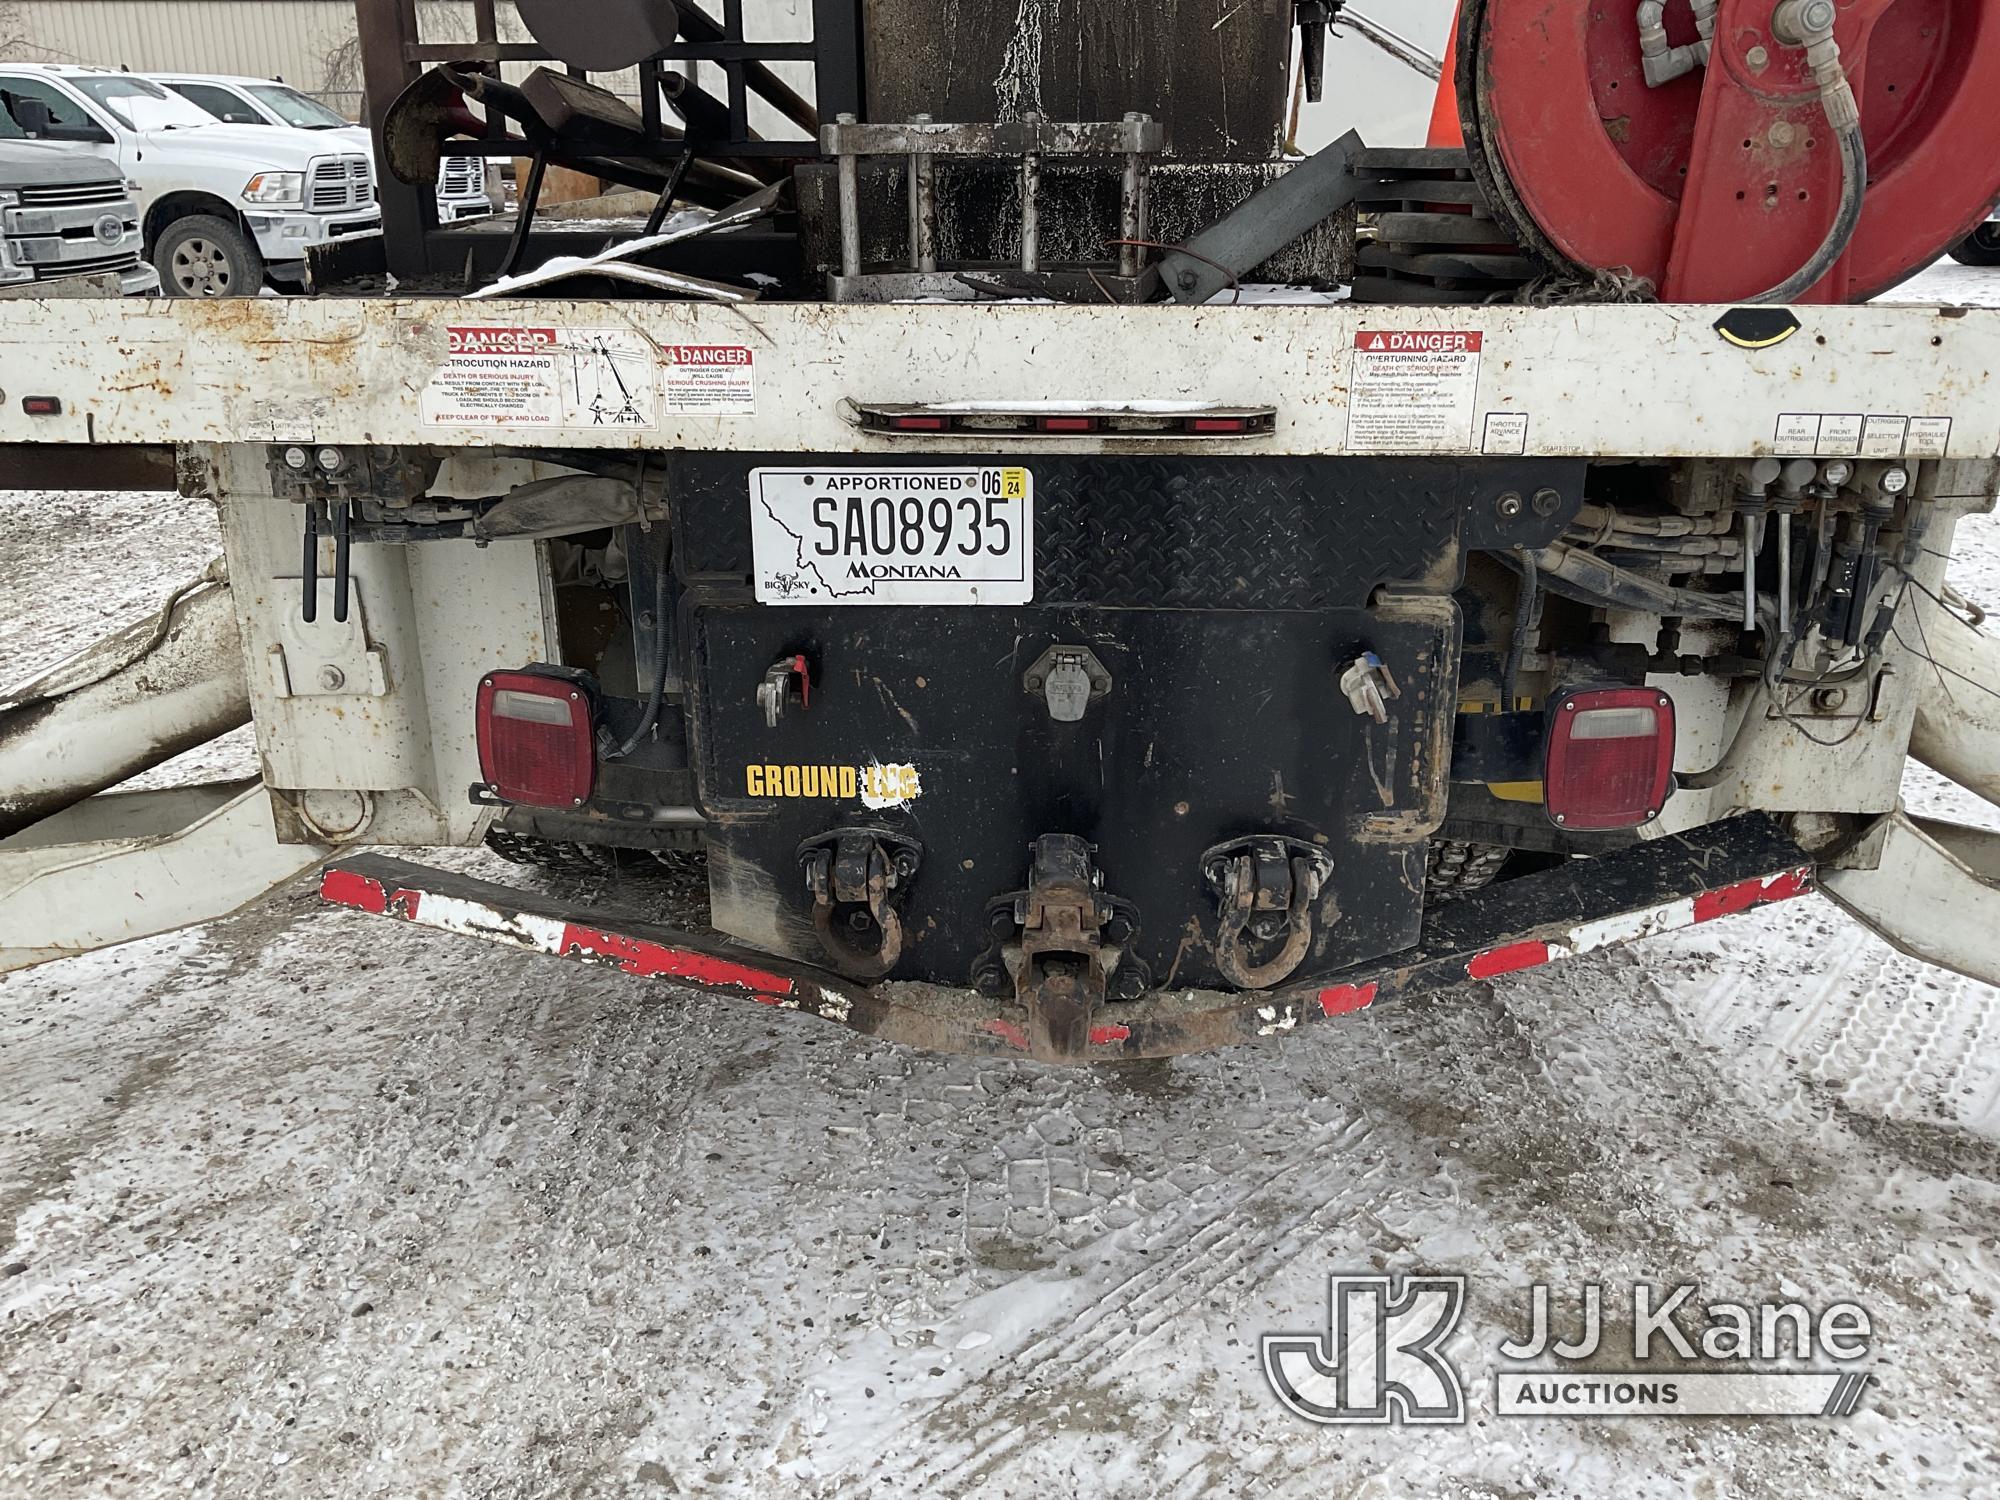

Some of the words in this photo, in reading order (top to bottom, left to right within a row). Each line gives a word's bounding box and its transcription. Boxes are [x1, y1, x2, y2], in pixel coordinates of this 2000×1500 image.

[1389, 334, 1466, 349] DANGER
[680, 349, 747, 363] DANGER
[509, 359, 551, 369] HAZARD
[826, 477, 962, 490] APPORTIONED
[981, 470, 1001, 495] 06
[1007, 481, 1020, 495] 24
[813, 497, 1010, 556] SA08935
[764, 581, 781, 590] BIG
[793, 581, 810, 590] SKY
[746, 764, 857, 798] GROUND
